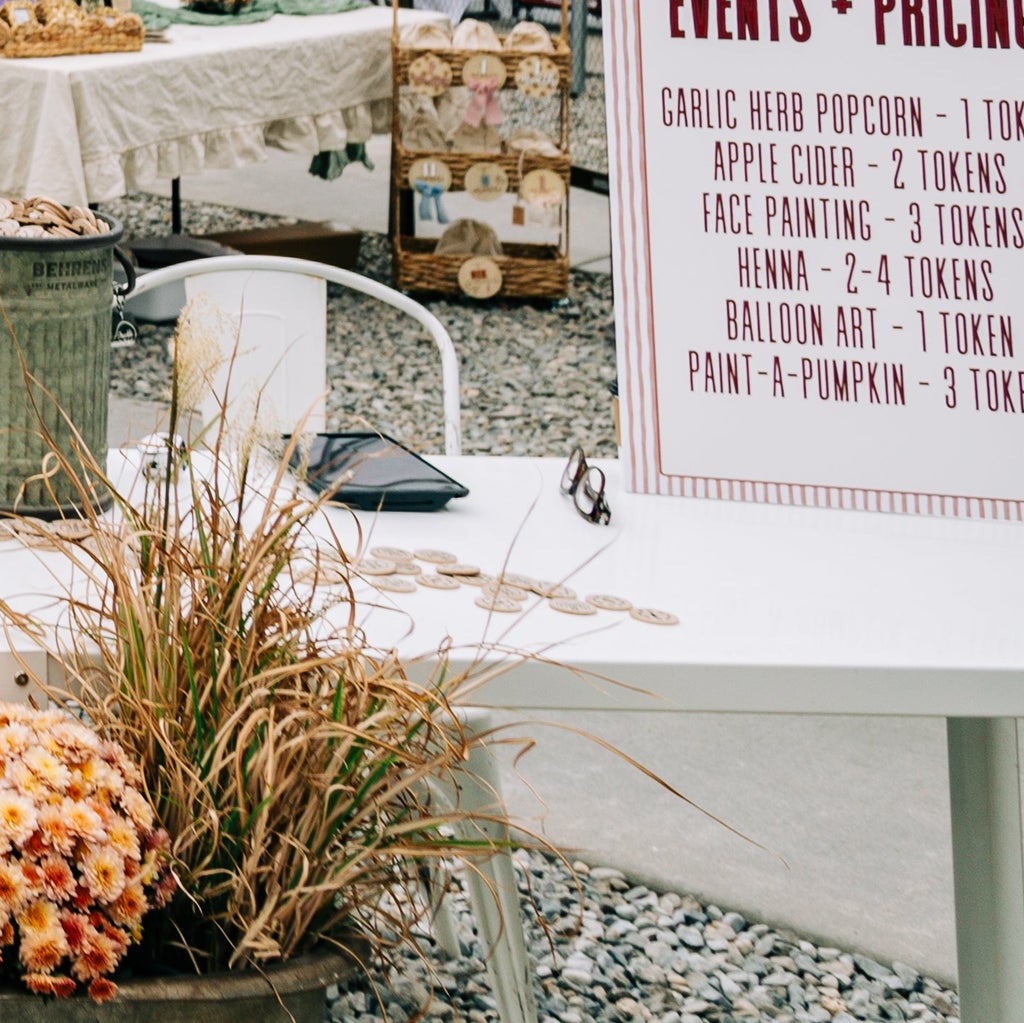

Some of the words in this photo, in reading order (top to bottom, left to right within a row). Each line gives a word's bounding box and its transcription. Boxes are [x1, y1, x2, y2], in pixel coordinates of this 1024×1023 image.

[662, 87, 737, 129] GARLIC
[750, 90, 803, 132] HERB
[816, 93, 922, 137] POPCORN
[959, 98, 970, 139] 1
[714, 141, 778, 184] APPLE
[791, 144, 854, 187] CIDER
[892, 148, 905, 189] 2
[917, 150, 1006, 194] TOKENS
[703, 193, 753, 235] FACE
[766, 196, 871, 241] PAINTING
[909, 202, 922, 243] 3
[934, 204, 1024, 249] TOKENS
[738, 247, 808, 291] HENNA
[845, 252, 890, 295] 2-4
[904, 256, 994, 302] TOKENS
[726, 299, 823, 346] BALLOON
[837, 306, 876, 349] ART
[916, 310, 926, 352] 1
[938, 312, 1013, 358] TOKEN
[689, 351, 906, 406] PAINT-A-PUMPKIN
[944, 366, 956, 408] 3
